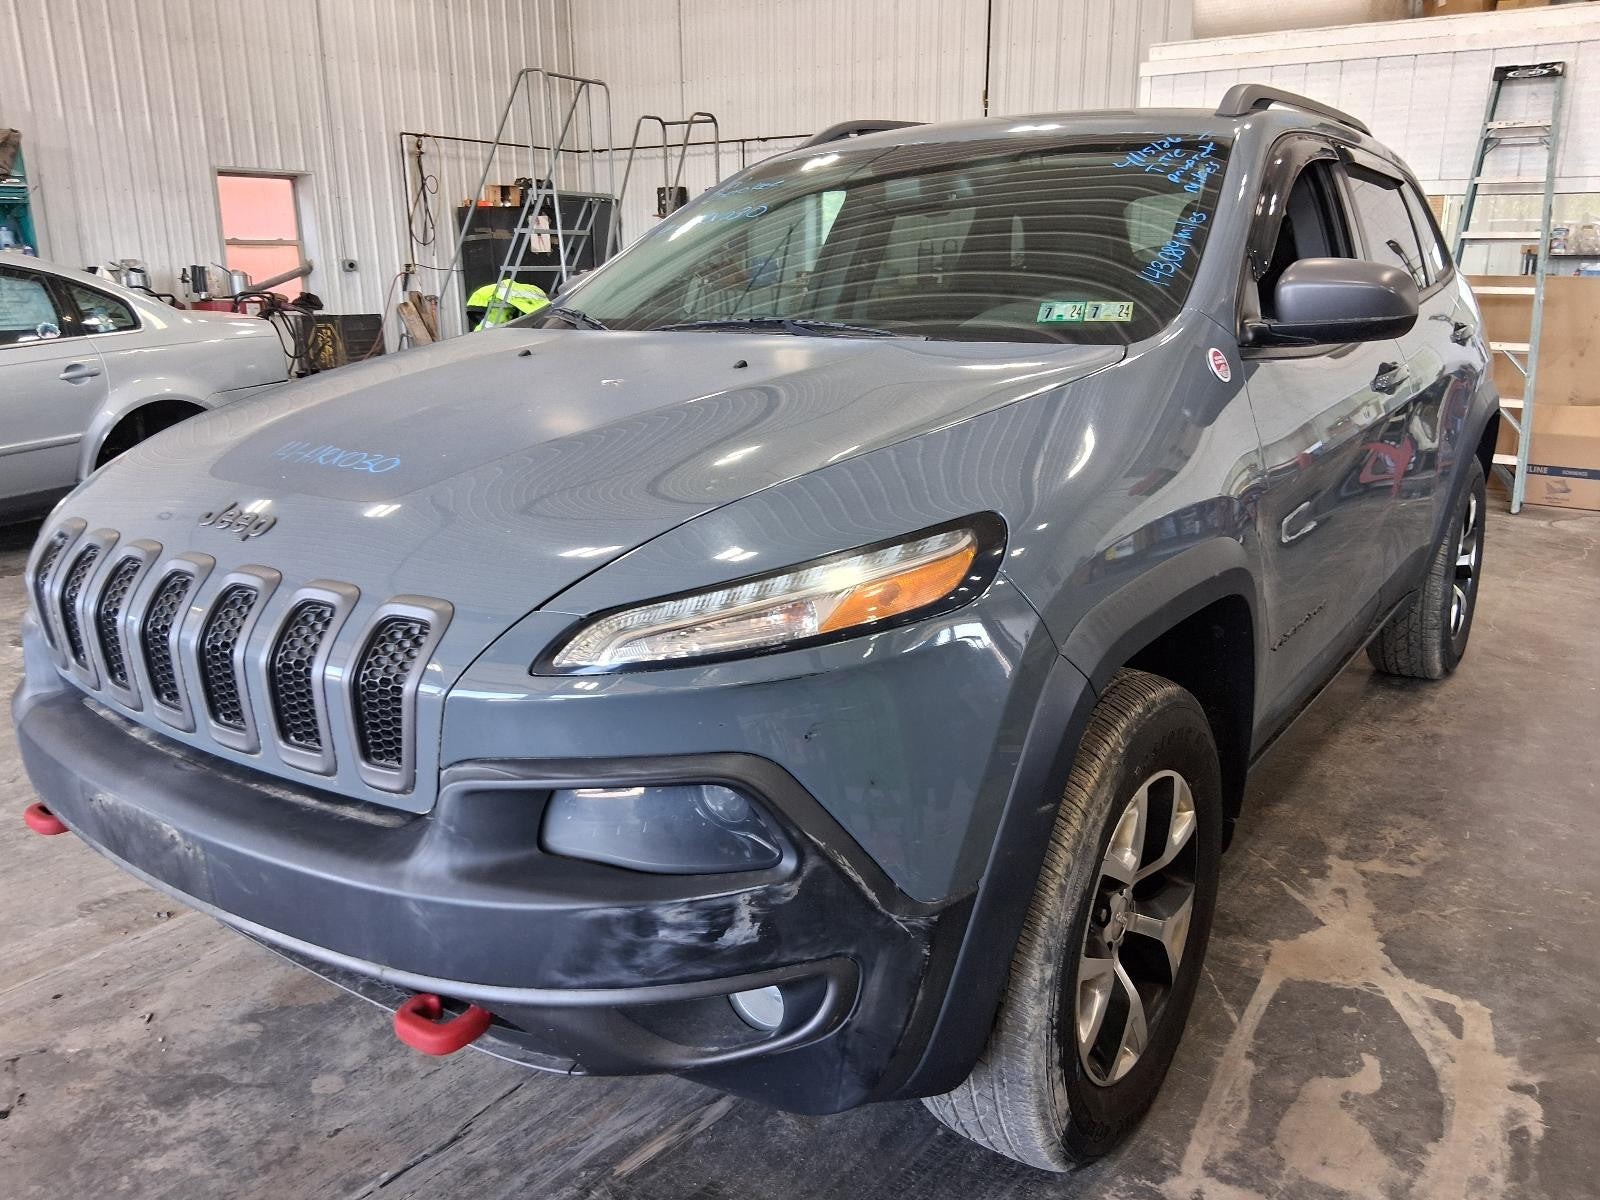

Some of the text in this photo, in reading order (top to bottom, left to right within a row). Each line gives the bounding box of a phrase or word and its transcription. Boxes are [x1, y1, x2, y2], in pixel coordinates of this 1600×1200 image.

[1044, 304, 1082, 319] 7 24
[1092, 304, 1130, 318] 7 24
[198, 501, 278, 542] Jeep
